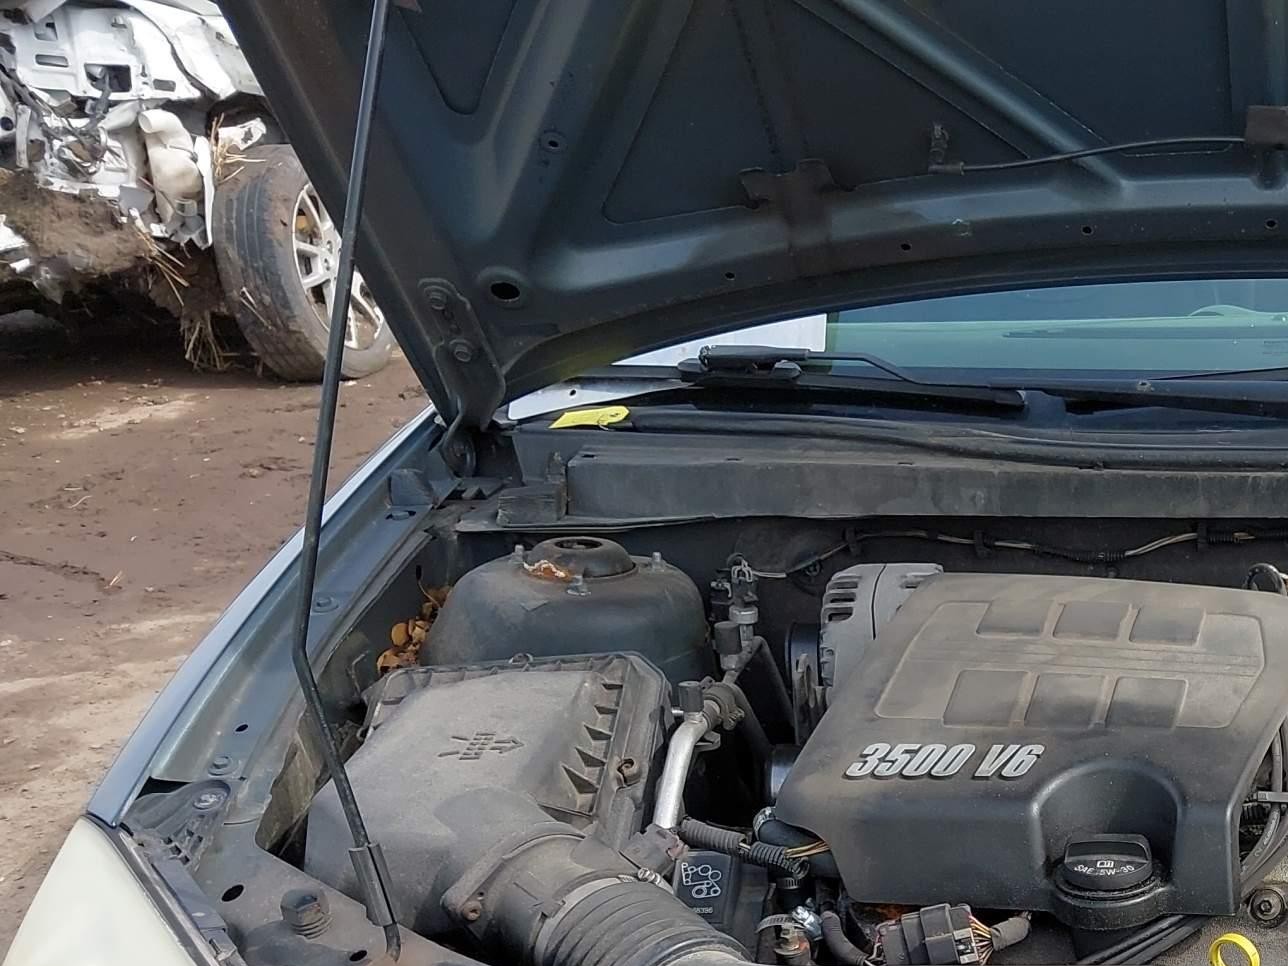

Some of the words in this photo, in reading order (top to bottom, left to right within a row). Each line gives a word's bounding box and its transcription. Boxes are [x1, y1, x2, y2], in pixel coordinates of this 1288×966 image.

[845, 742, 976, 778] 3500
[974, 744, 1046, 778] V6
[1074, 864, 1094, 875] SAE
